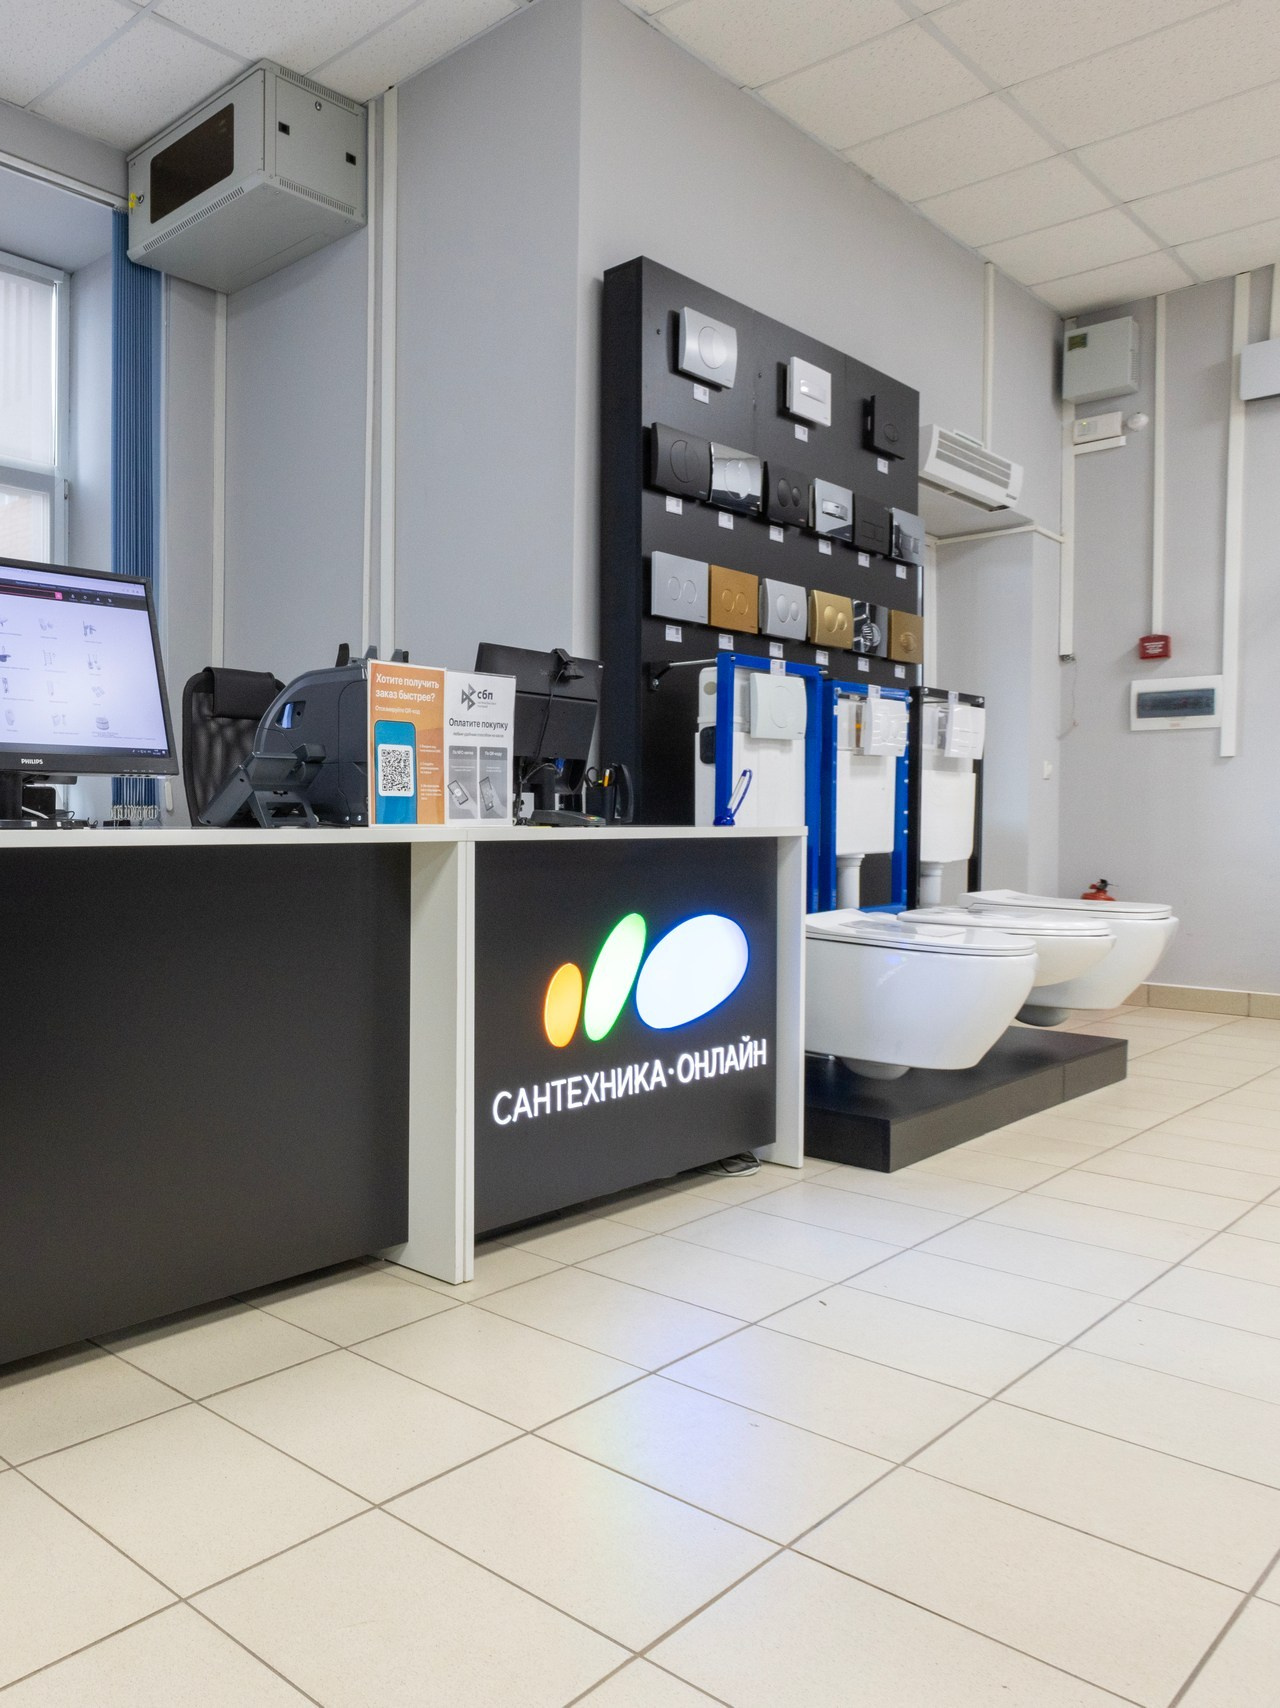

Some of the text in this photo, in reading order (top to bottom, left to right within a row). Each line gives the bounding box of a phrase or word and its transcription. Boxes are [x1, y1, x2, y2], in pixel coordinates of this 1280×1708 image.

[376, 673, 440, 689] Хотите получить
[375, 690, 435, 702] заказ быстрее?
[449, 717, 508, 731] Оплатите покупку
